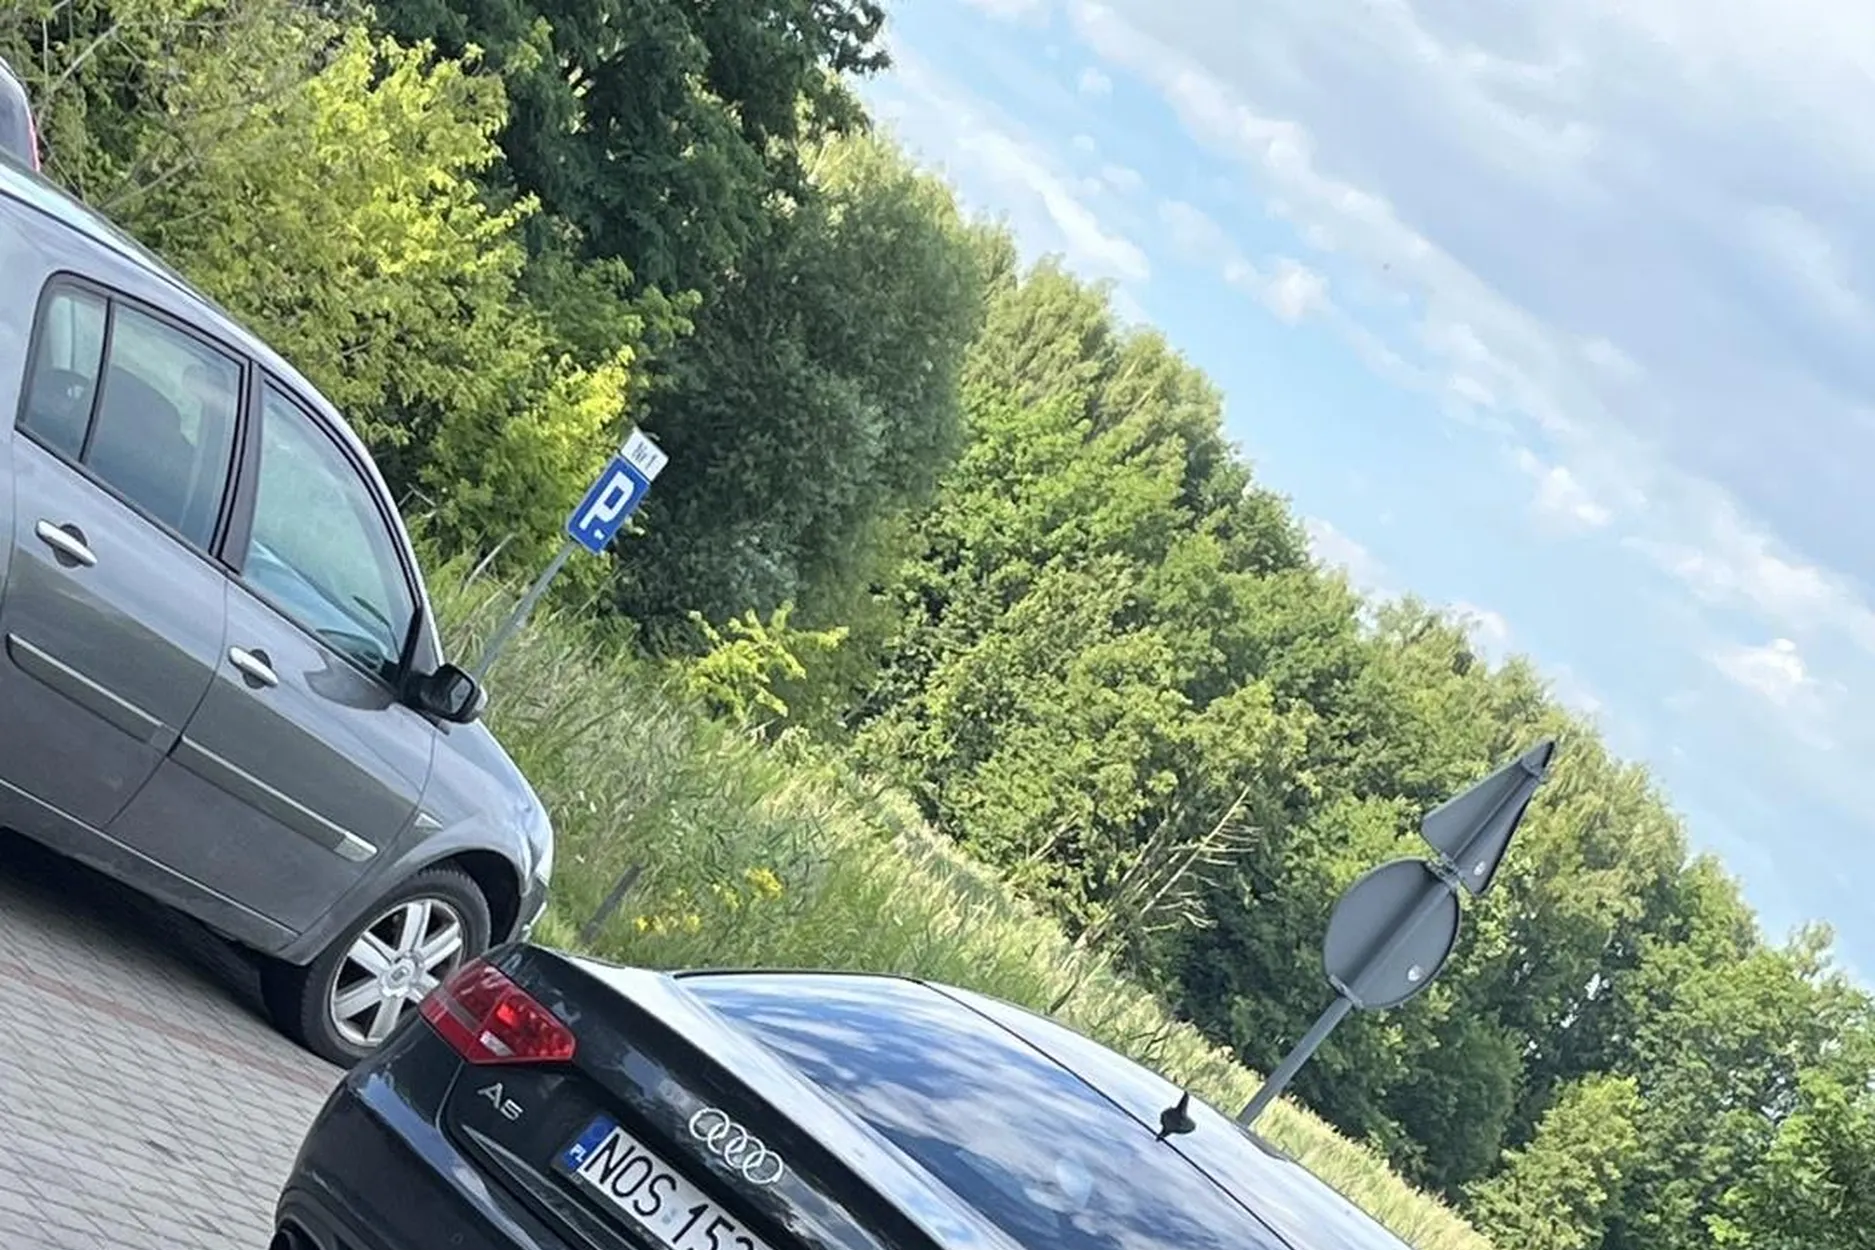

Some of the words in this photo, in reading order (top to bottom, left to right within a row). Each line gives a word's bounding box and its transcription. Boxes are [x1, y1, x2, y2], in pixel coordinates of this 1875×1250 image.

[579, 471, 635, 531] P
[477, 1083, 524, 1121] A5
[570, 1144, 586, 1163] PL
[584, 1133, 677, 1217] NOS
